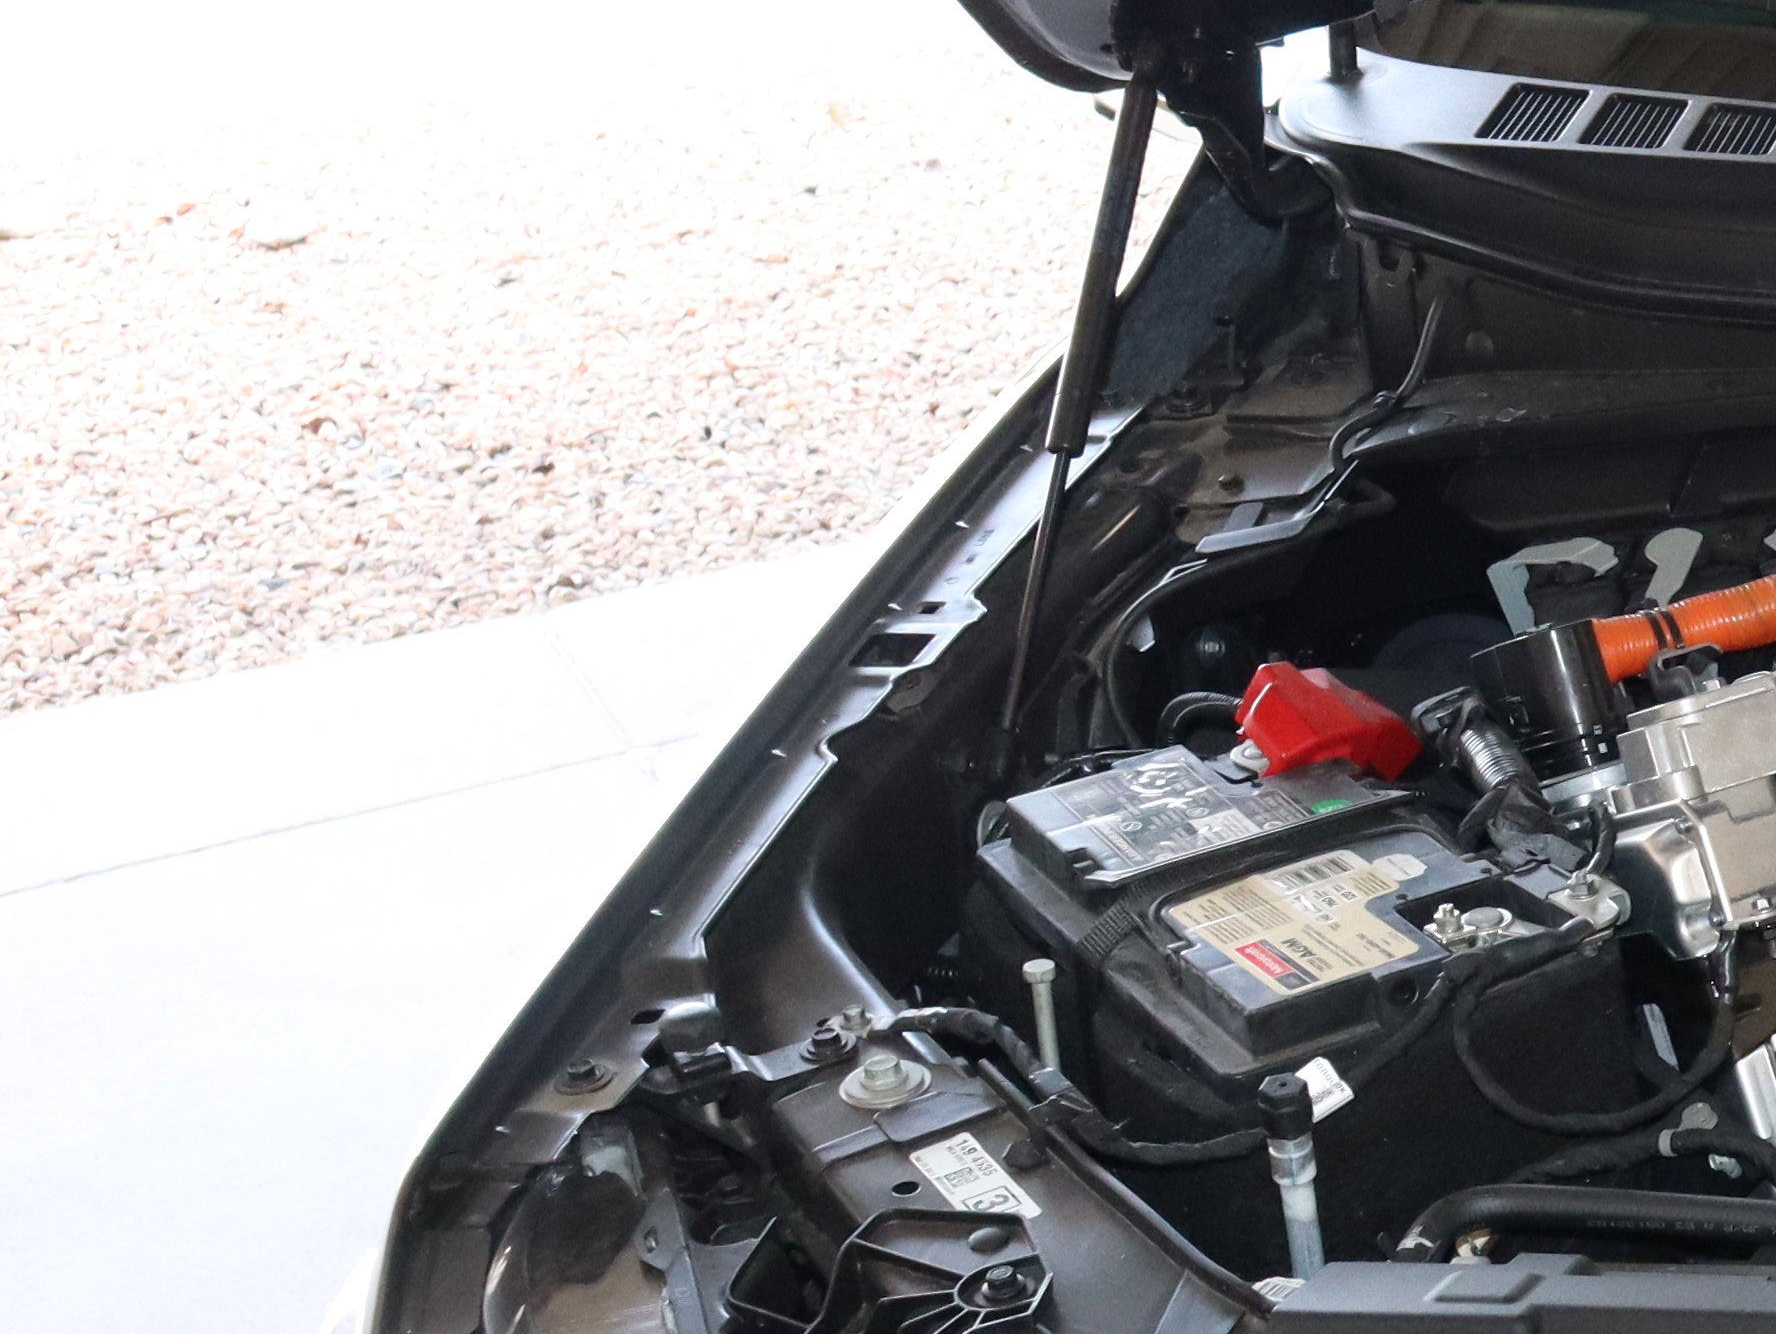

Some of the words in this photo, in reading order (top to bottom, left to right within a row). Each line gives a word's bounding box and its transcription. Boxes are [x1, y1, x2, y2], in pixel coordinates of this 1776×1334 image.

[1245, 944, 1286, 976] Motorcraft
[1280, 937, 1317, 960] AGM
[972, 1193, 1010, 1212] 3
